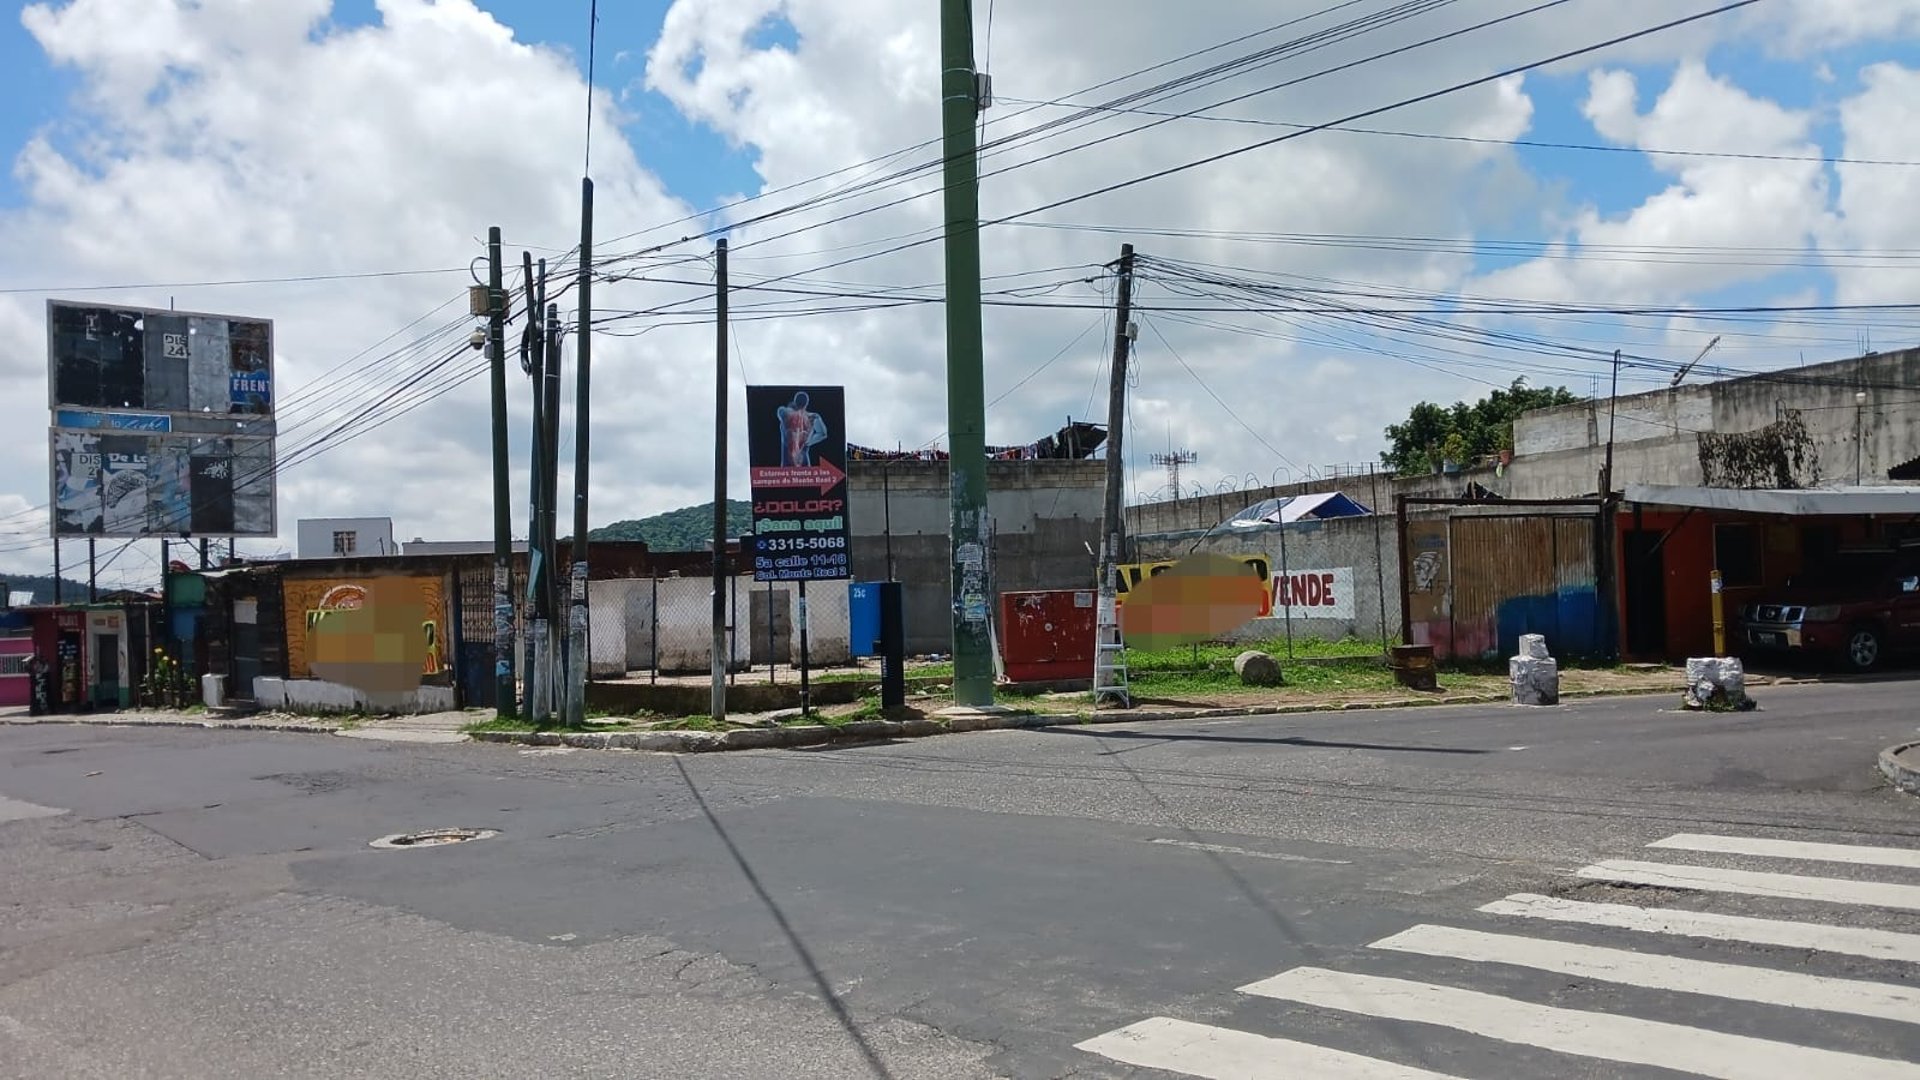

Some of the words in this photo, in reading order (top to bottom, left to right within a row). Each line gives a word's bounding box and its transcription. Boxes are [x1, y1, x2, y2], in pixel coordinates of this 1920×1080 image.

[233, 379, 268, 392] FREN
[754, 500, 843, 514] ¿DOLOR?
[768, 537, 845, 551] 3315-5068
[774, 555, 808, 567] calle
[778, 568, 812, 578] Monte
[813, 567, 838, 577] Real
